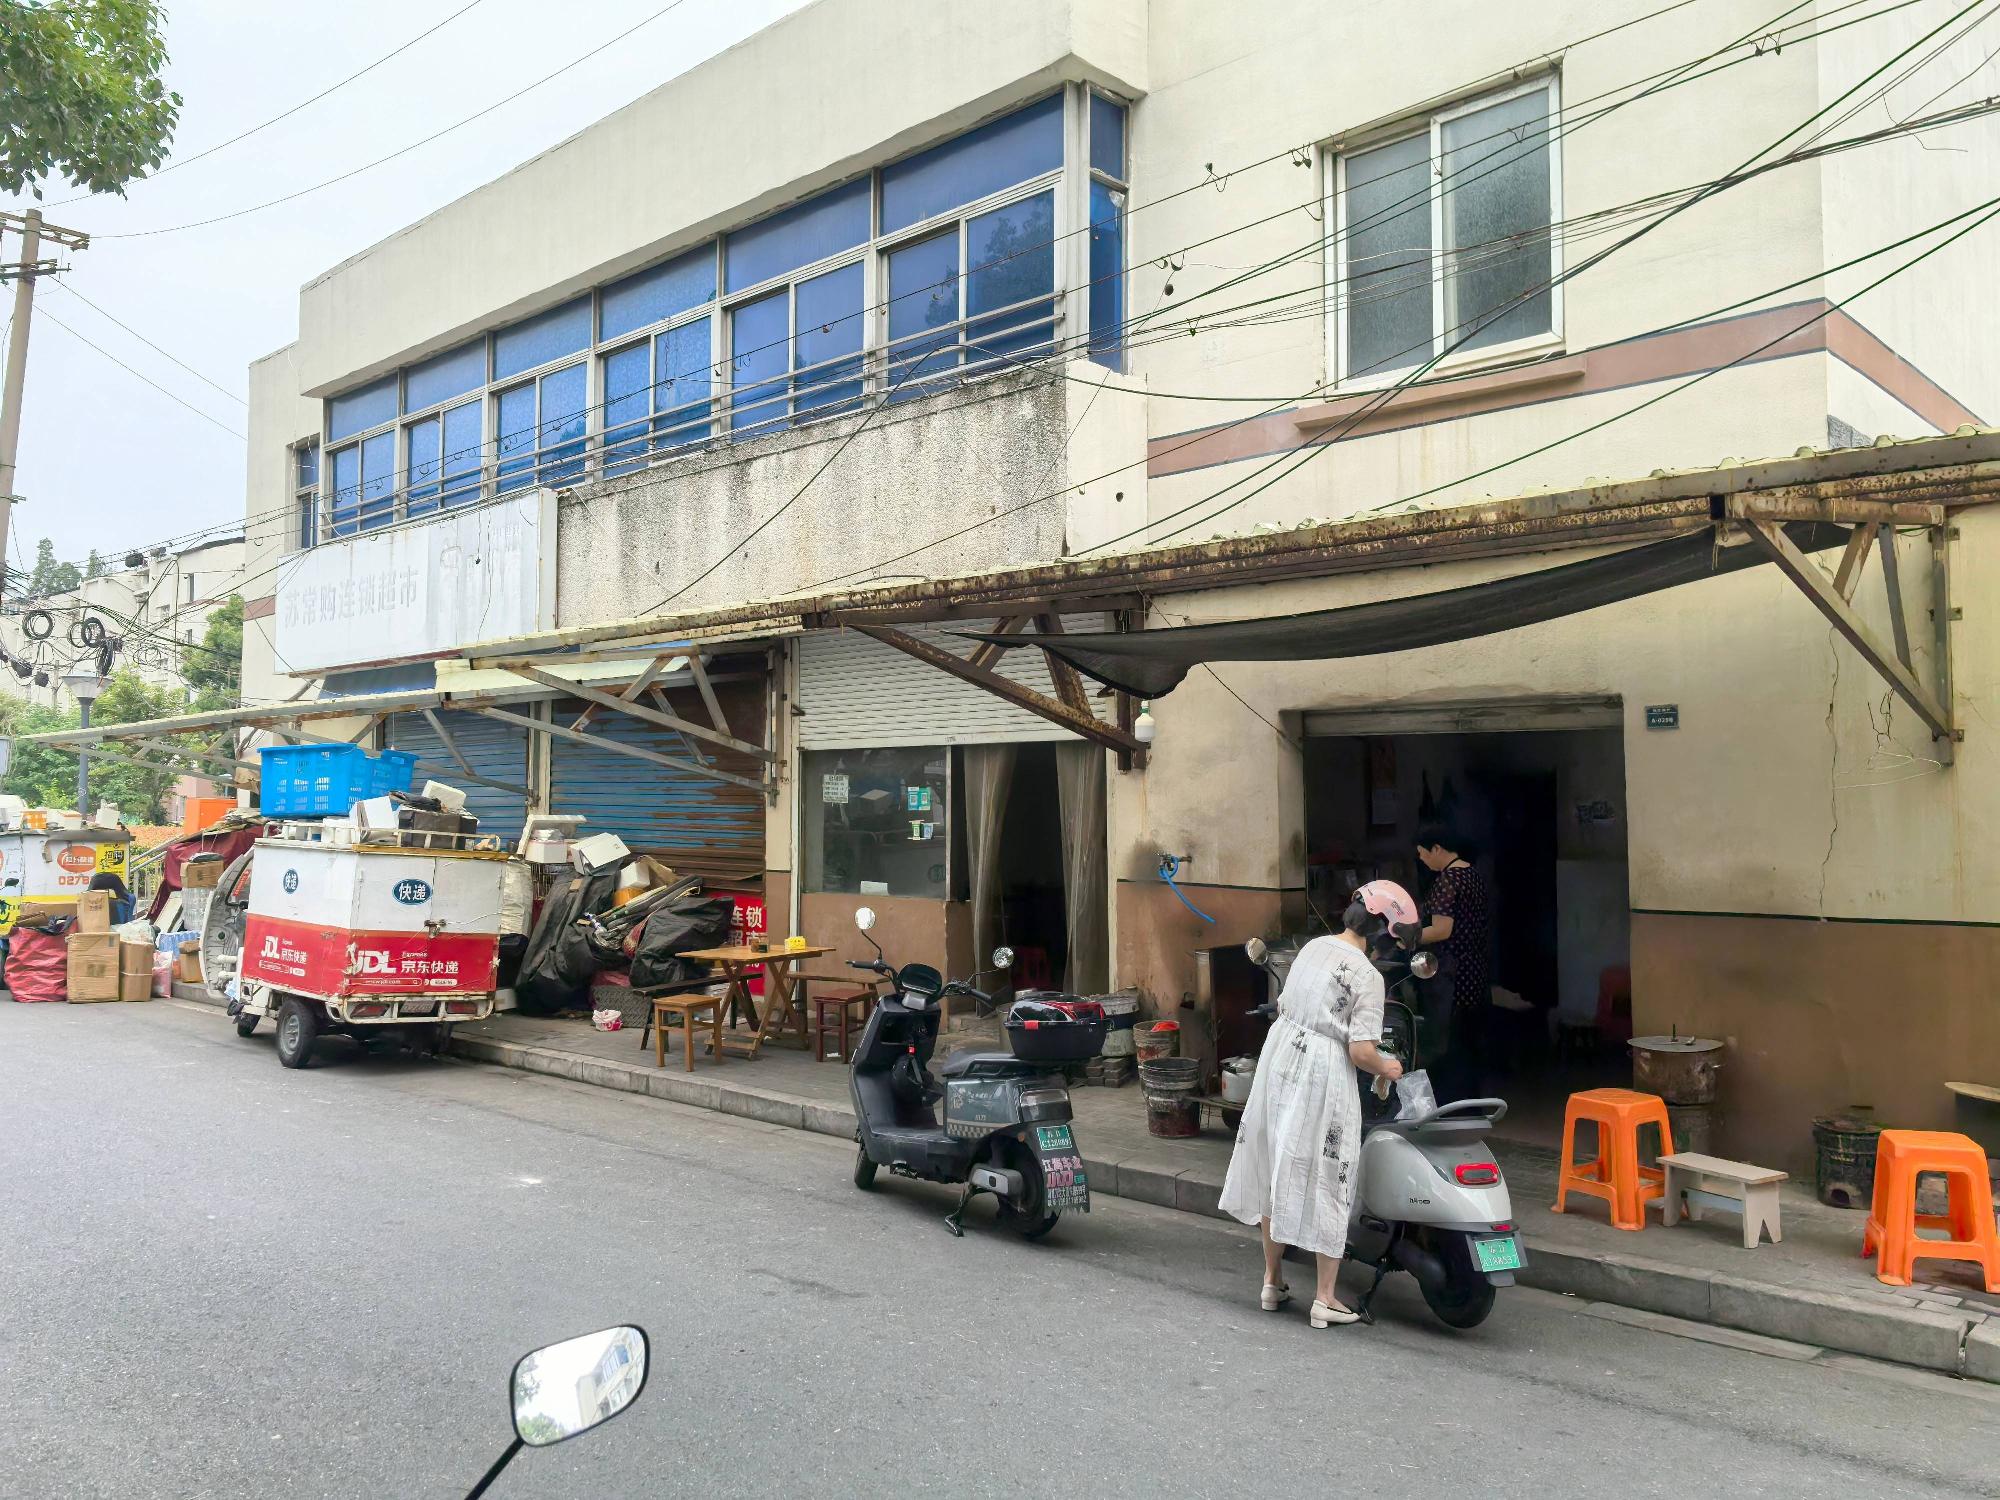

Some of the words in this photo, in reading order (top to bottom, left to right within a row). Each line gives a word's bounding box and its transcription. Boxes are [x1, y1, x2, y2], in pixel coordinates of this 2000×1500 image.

[284, 566, 419, 628] 苏常购连锁超市
[285, 872, 297, 890] 快递
[398, 882, 426, 901] 快递
[731, 905, 763, 929] 连锁
[261, 935, 280, 959] JDL
[354, 950, 397, 974] JDL
[401, 960, 459, 974] 京东快递
